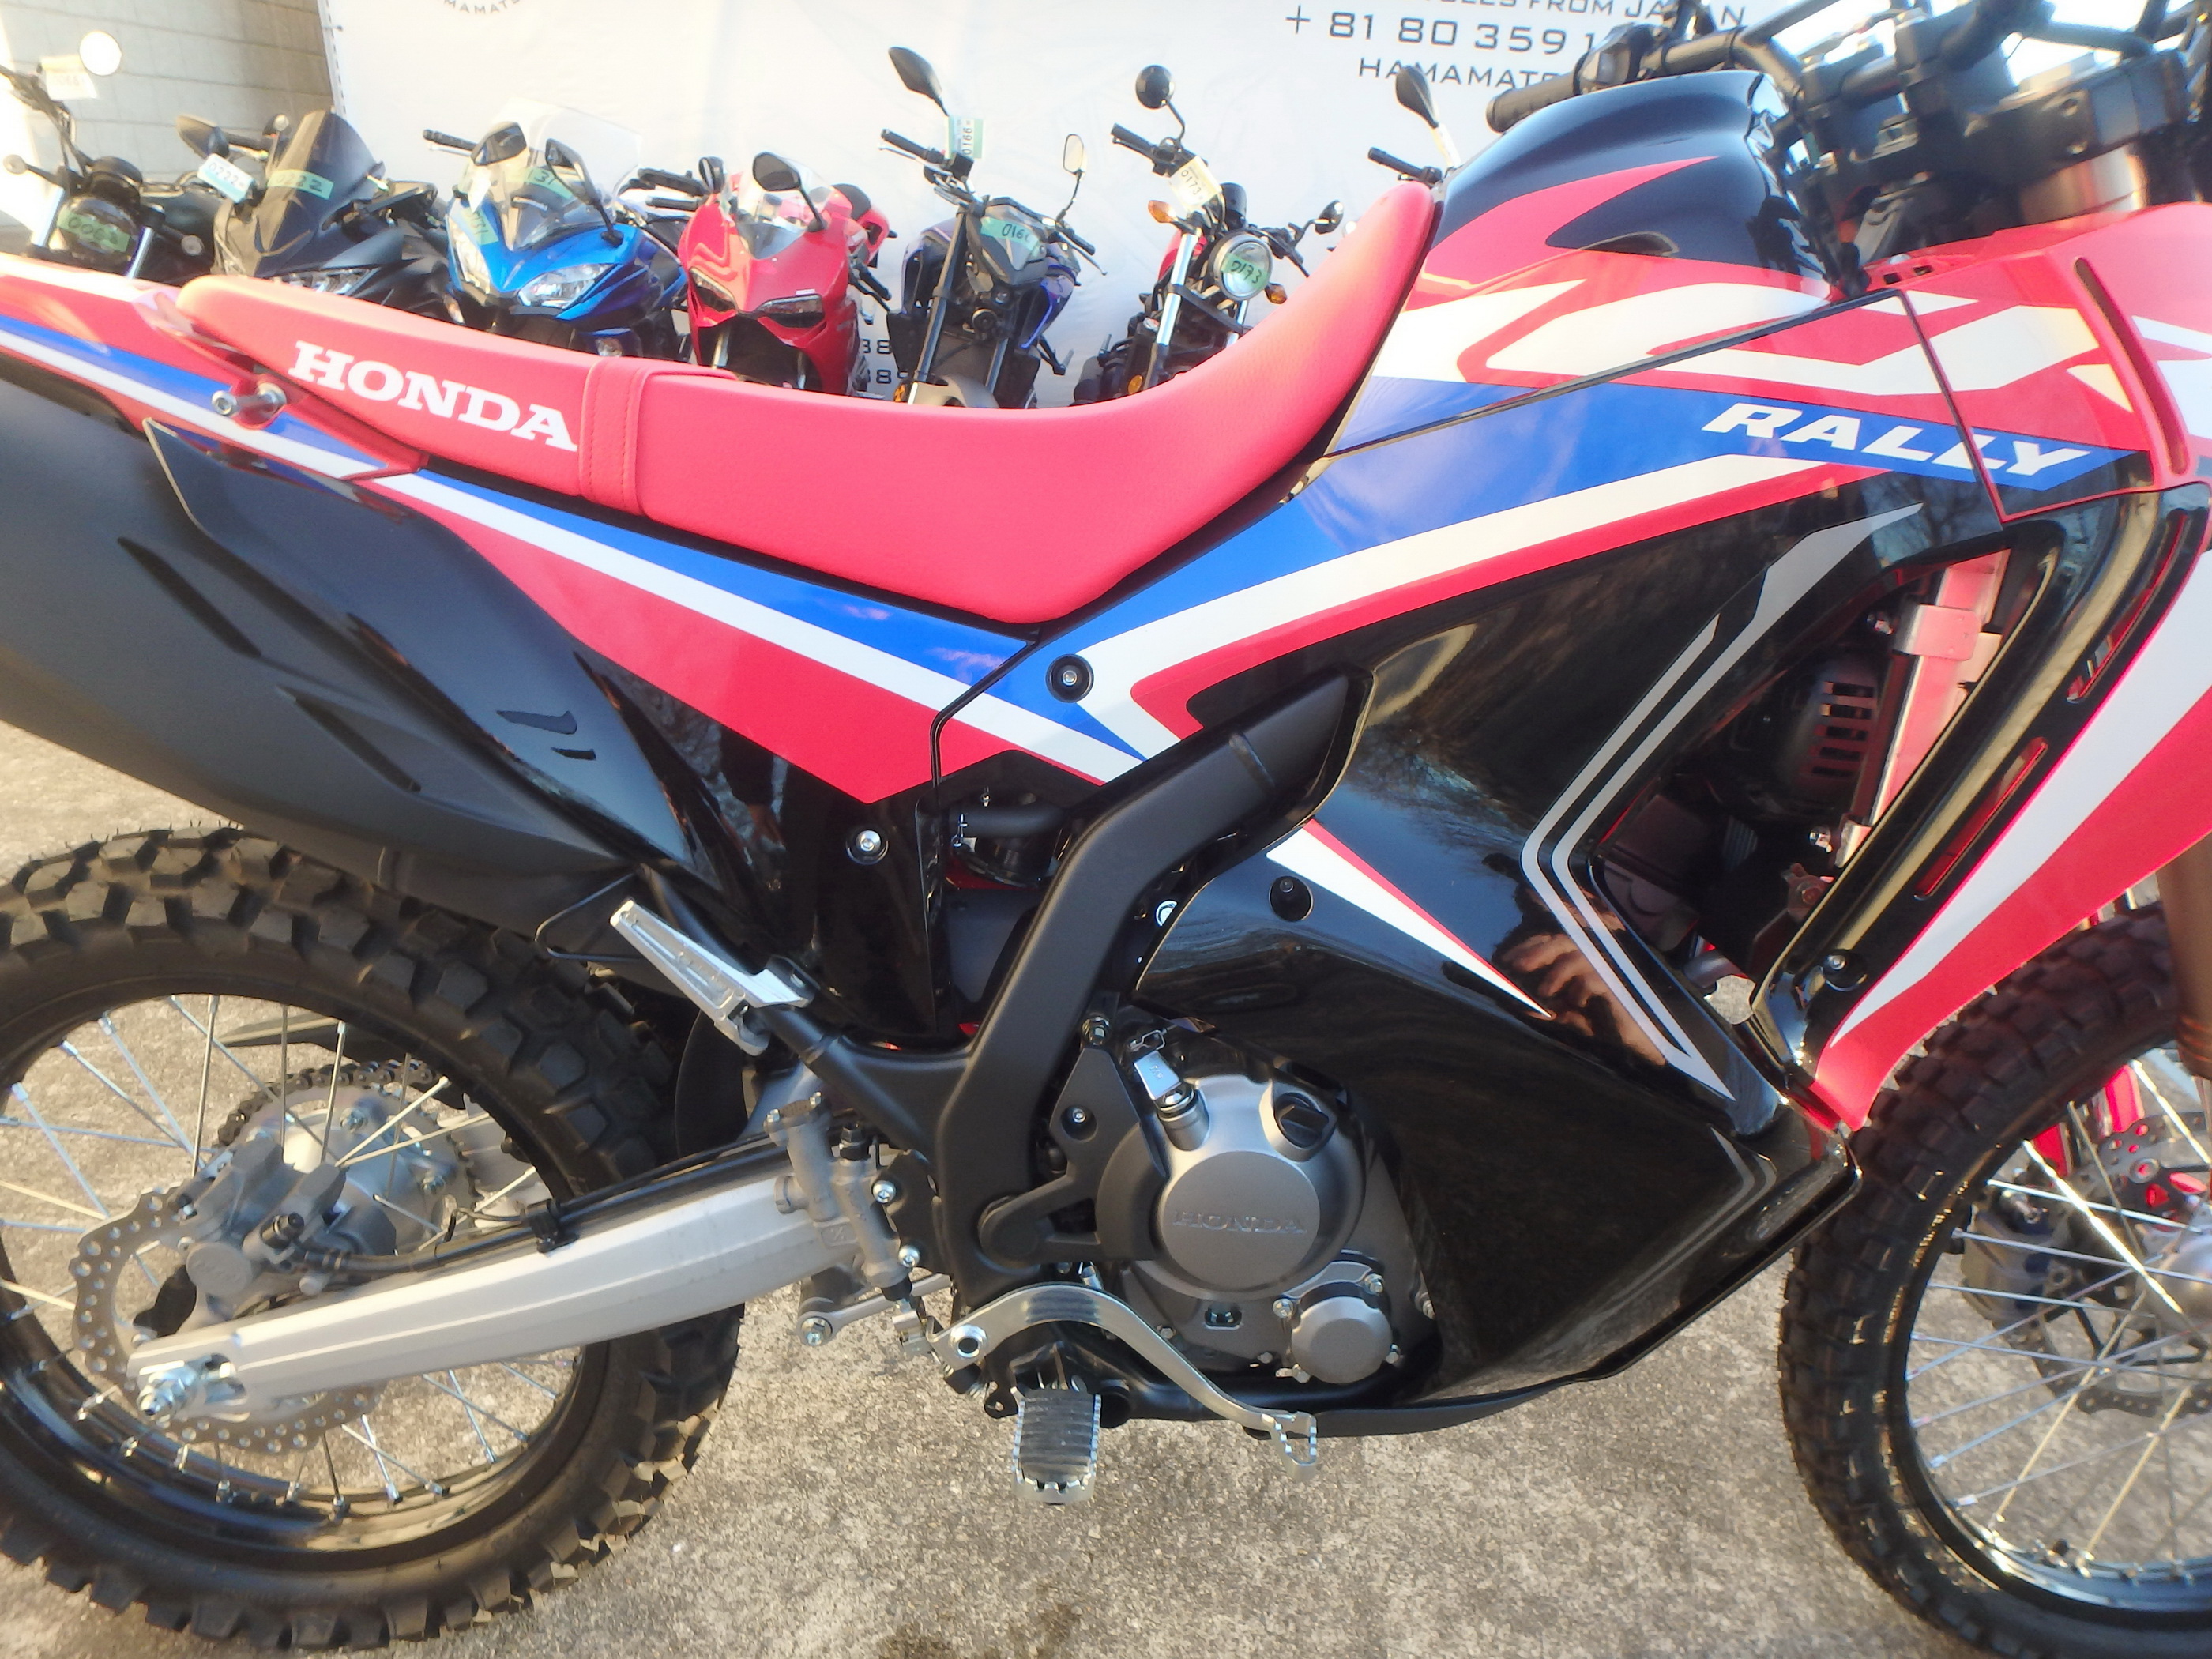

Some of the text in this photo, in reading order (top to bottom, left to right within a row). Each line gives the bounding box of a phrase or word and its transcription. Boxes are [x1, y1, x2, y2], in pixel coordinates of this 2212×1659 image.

[1330, 11, 1374, 40] 81
[1398, 17, 1458, 46] 80
[1474, 23, 1567, 55] 359
[961, 127, 973, 155] 0166
[1181, 169, 1202, 195] 0173
[1230, 260, 1262, 284] 0173
[288, 340, 578, 453] HONDA
[1701, 401, 2092, 476] RALLY
[1172, 1211, 1308, 1235] HONDA
